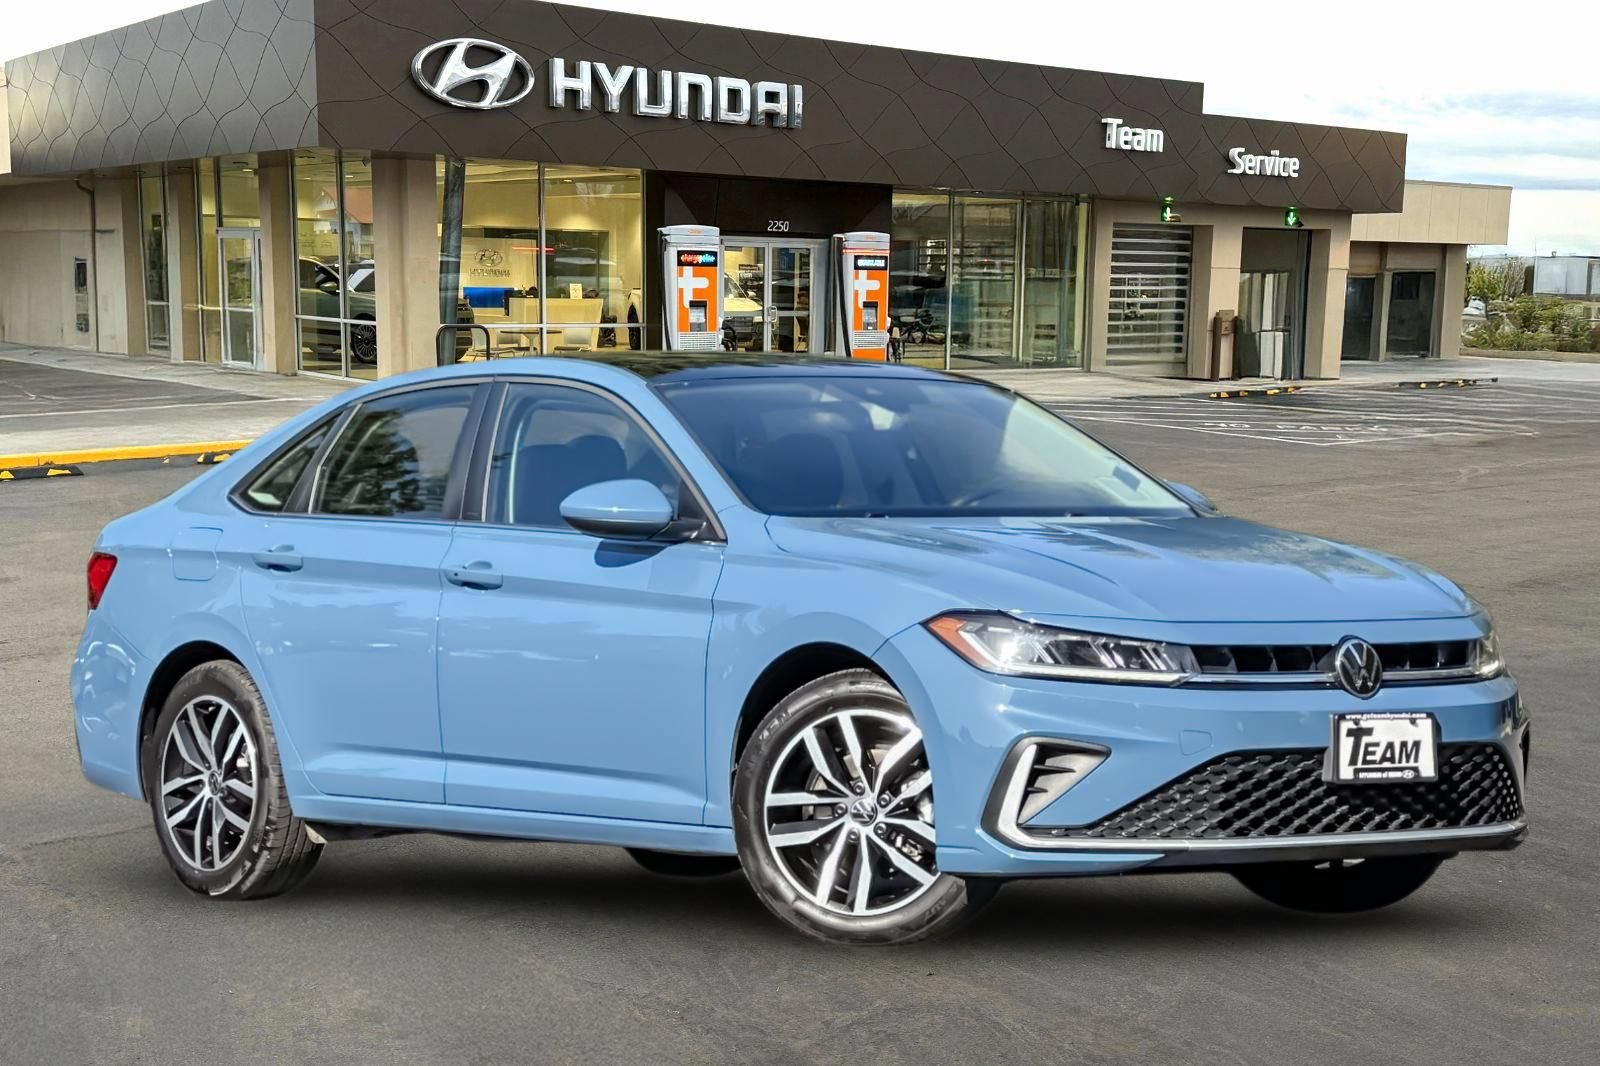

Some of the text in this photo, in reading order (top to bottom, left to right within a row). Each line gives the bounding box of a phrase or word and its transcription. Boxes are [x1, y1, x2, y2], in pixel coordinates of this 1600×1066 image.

[548, 57, 803, 129] HYUNDAI
[1101, 117, 1164, 152] Team
[1227, 147, 1300, 177] Service
[767, 220, 790, 232] 2250
[1345, 727, 1422, 767] TEAM
